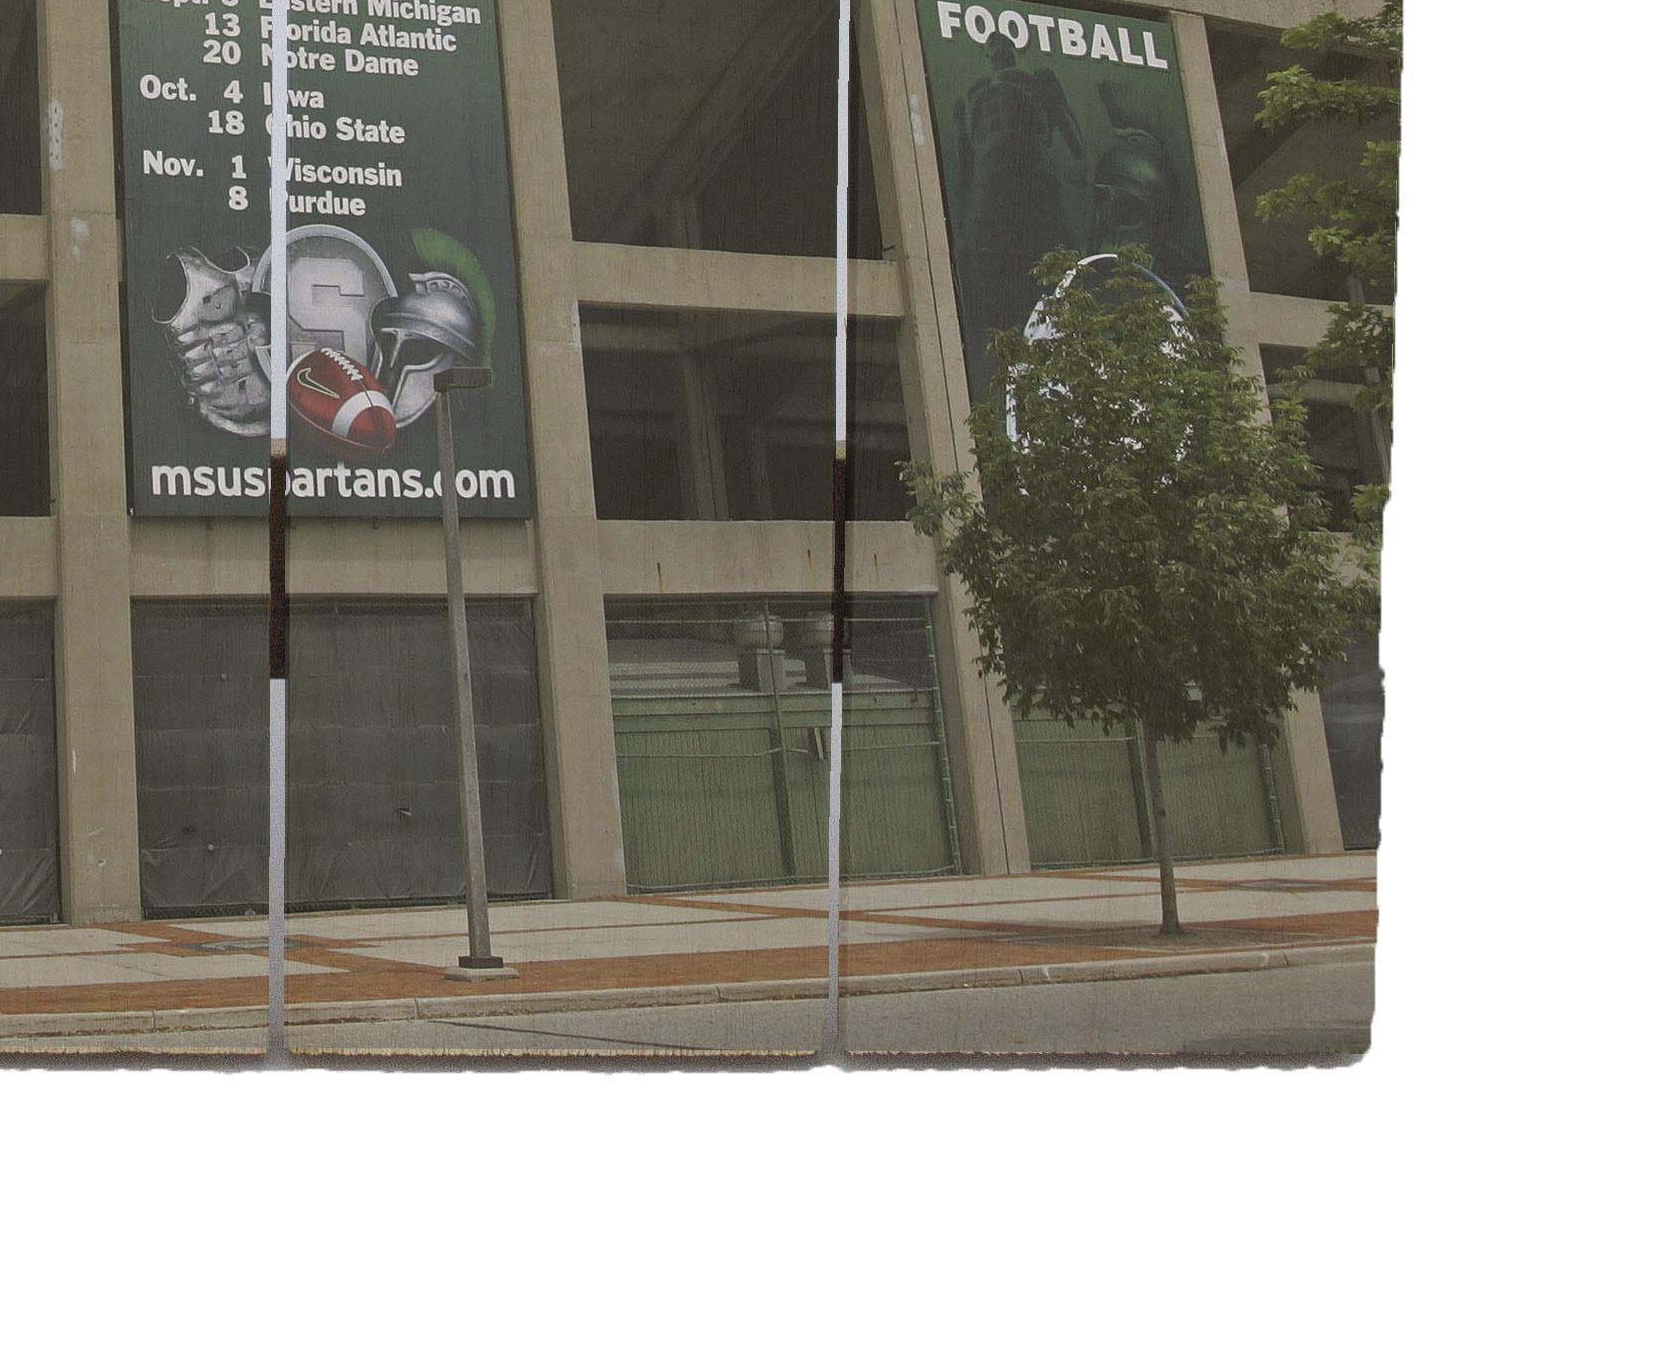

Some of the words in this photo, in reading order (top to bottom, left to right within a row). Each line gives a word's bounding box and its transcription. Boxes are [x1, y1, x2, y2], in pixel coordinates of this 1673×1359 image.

[204, 13, 241, 37] 13
[260, 15, 352, 44] Forida
[360, 22, 457, 52] Atlantic
[937, 0, 1169, 70] FOOTBALL
[203, 40, 242, 65] 20
[344, 48, 420, 76] Dame
[139, 75, 197, 101] Oct.
[223, 80, 244, 104] 4
[263, 81, 325, 109] Iwa
[208, 110, 246, 135] 18
[335, 116, 406, 144] State
[143, 150, 204, 177] Nov.
[230, 154, 247, 179] 1
[228, 185, 249, 211] 8
[268, 187, 367, 217] urdue
